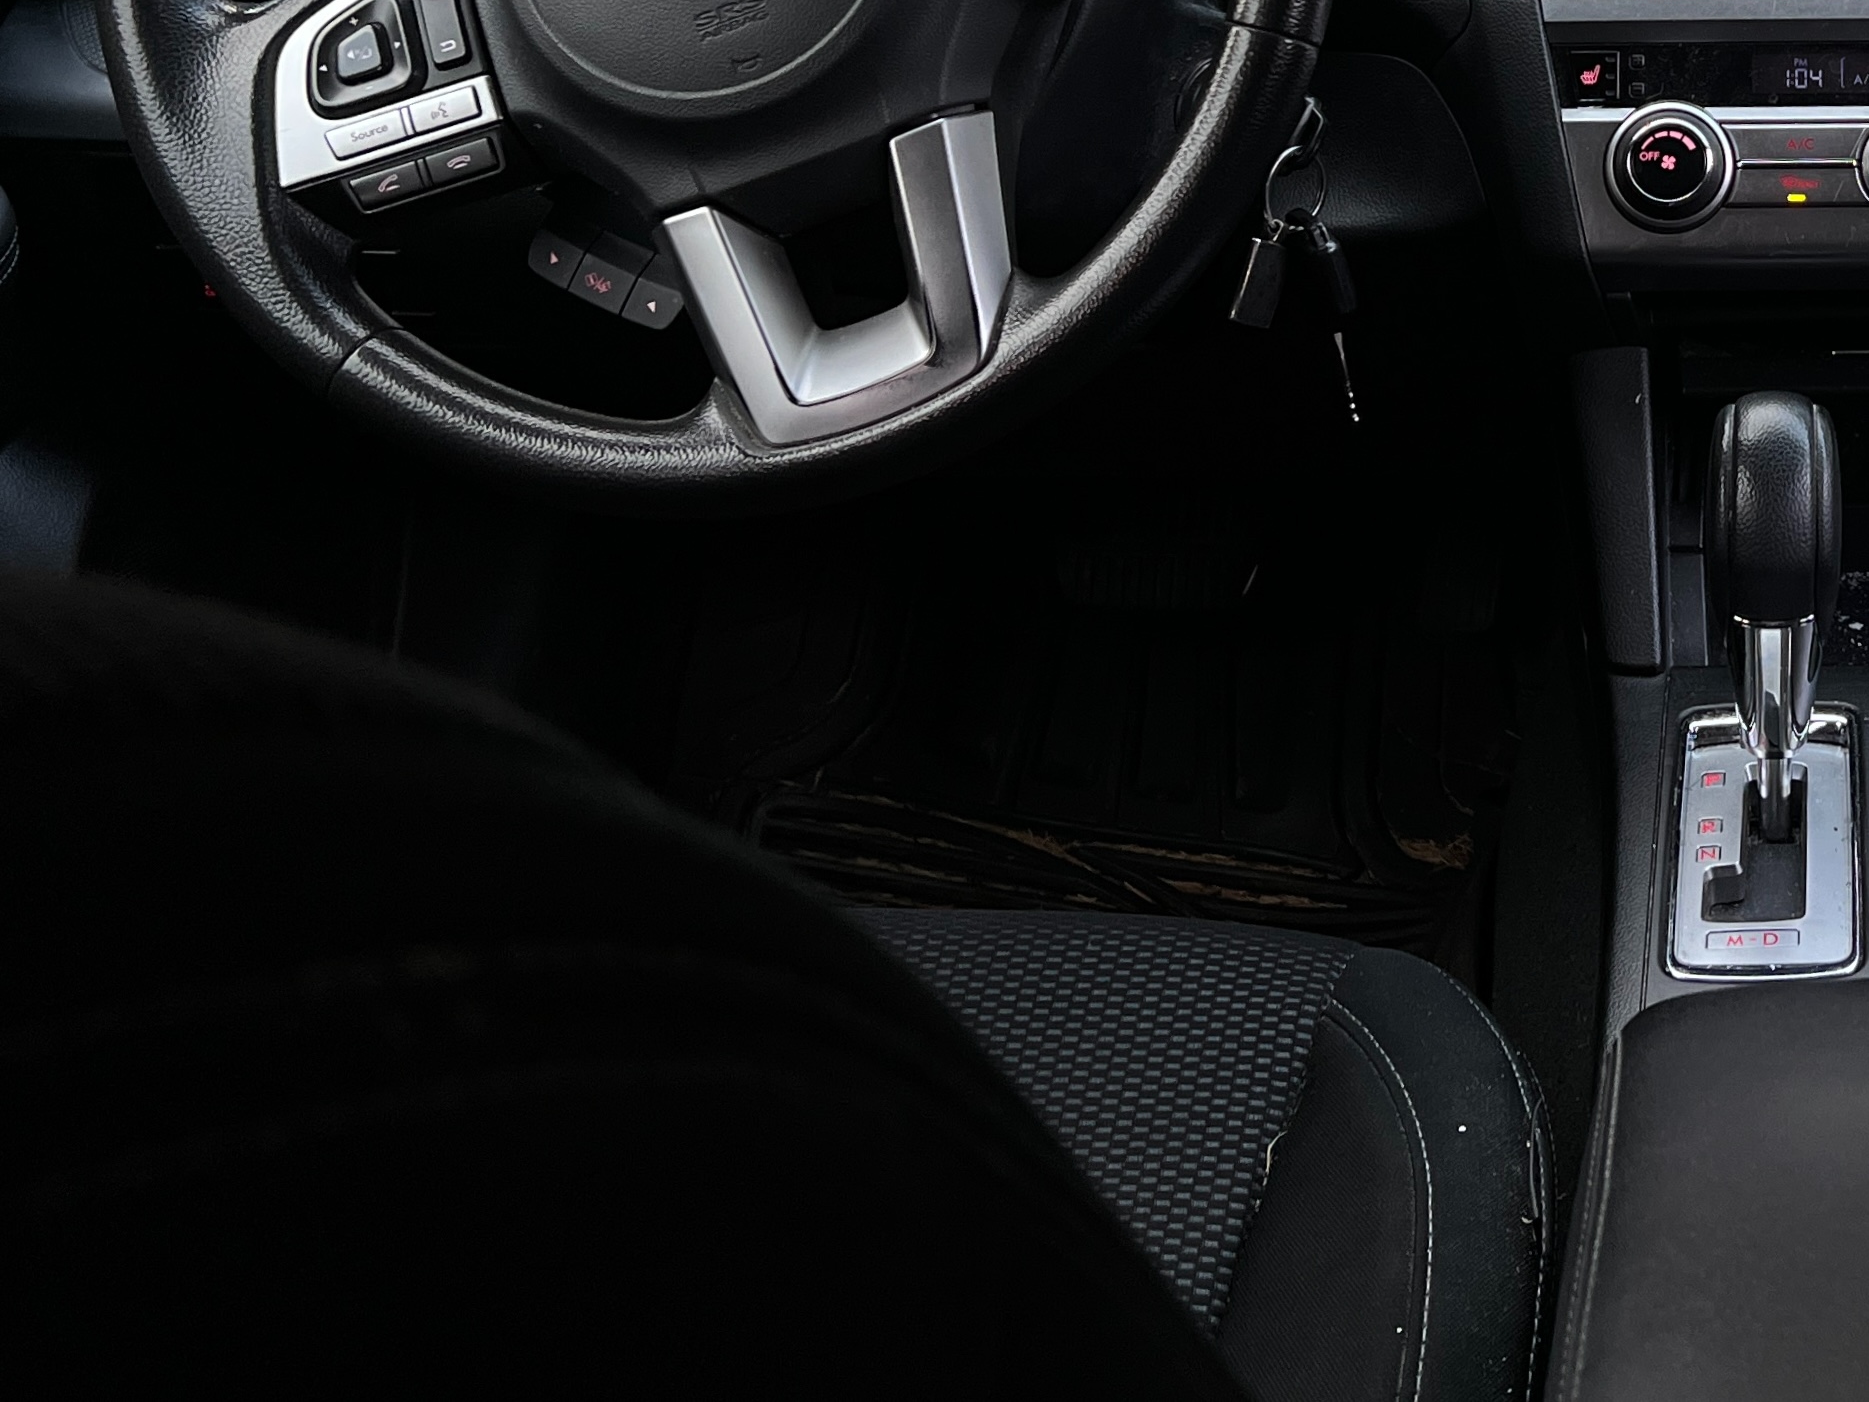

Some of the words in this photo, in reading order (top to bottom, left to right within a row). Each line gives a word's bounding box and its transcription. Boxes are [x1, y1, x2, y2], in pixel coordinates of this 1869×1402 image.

[1793, 57, 1808, 67] PM
[1786, 67, 1823, 89] 1:04
[350, 123, 389, 143] Source
[1786, 137, 1815, 151] A/C
[1639, 151, 1661, 162] OFF
[1705, 774, 1720, 787] P
[1701, 821, 1715, 833] R
[1701, 849, 1715, 860] N
